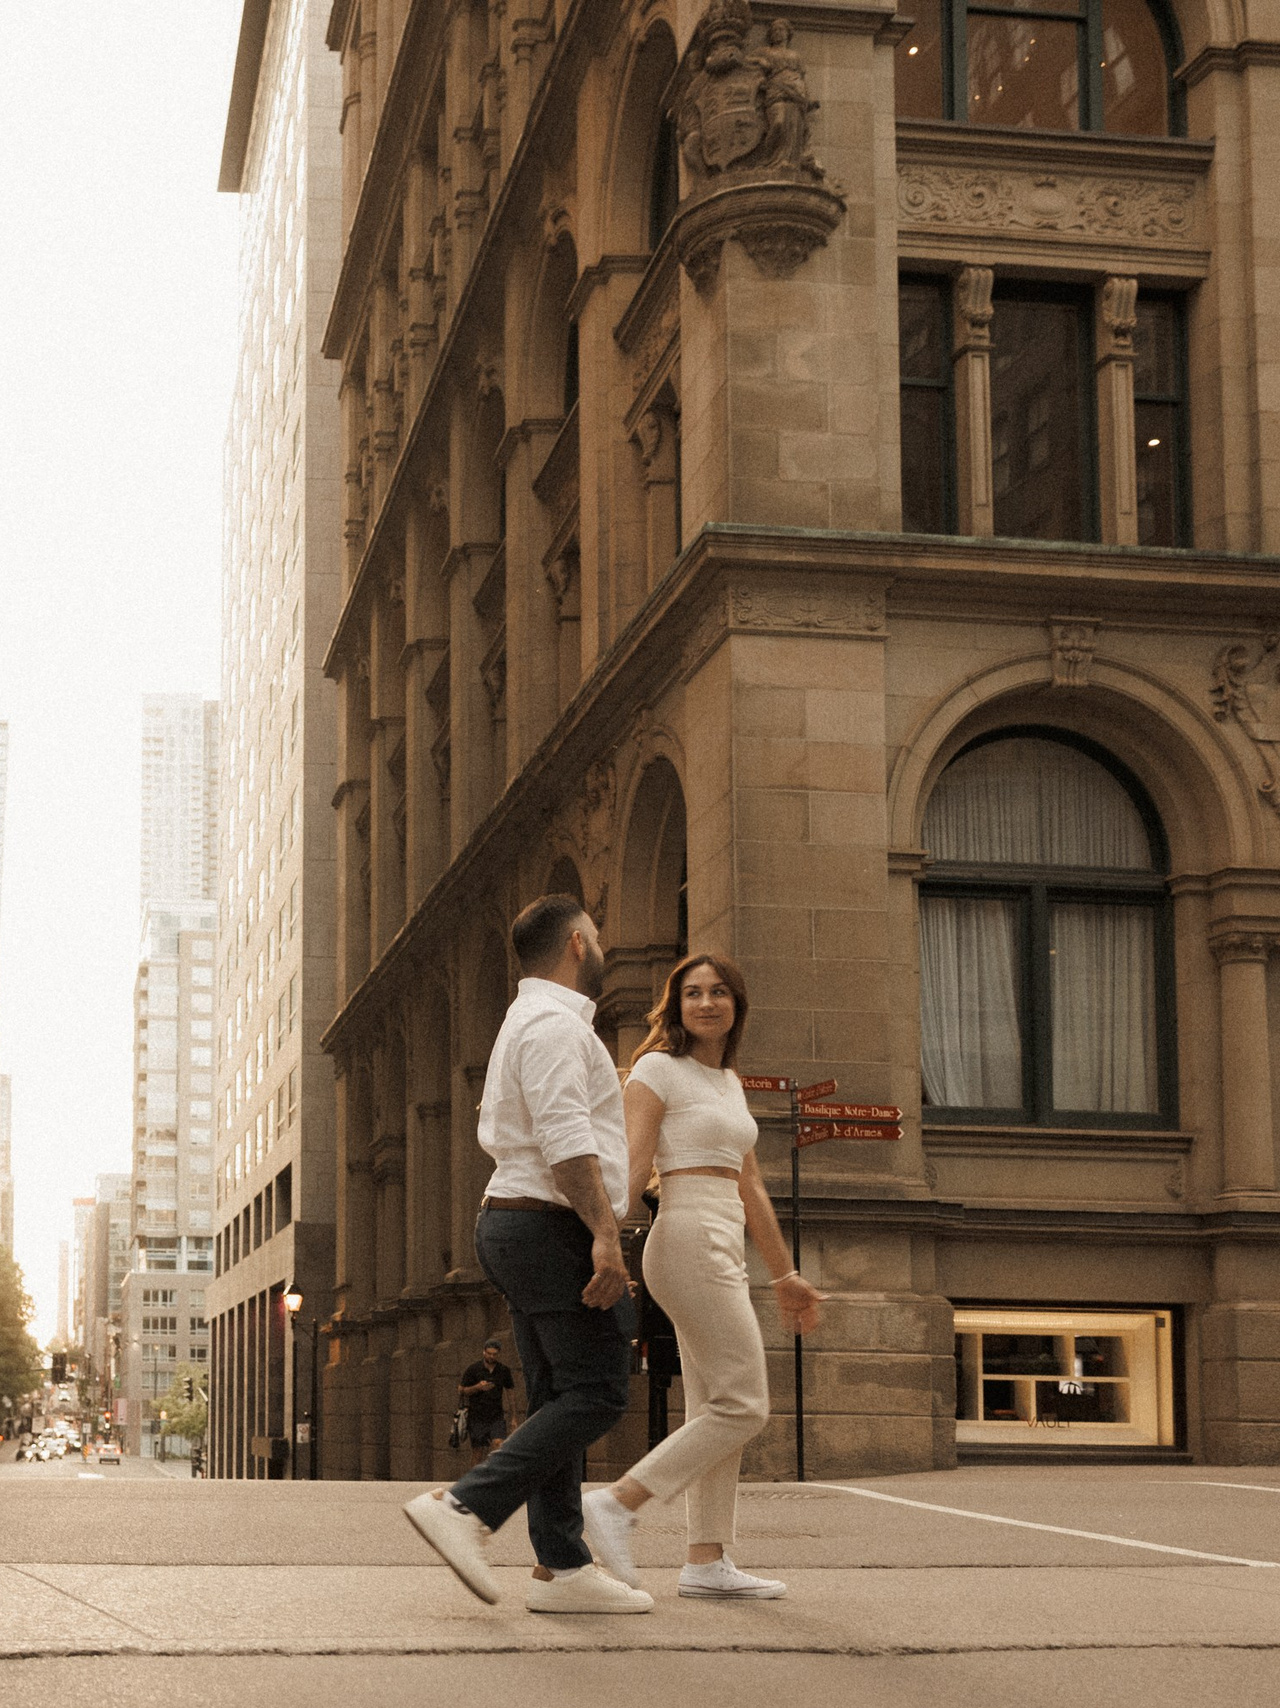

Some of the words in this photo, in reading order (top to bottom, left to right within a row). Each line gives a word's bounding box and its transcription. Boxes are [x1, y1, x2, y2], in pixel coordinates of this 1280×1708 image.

[804, 1103, 841, 1118] Basilique
[844, 1105, 894, 1118] Notre-Dame
[844, 1126, 882, 1138] d'Armes
